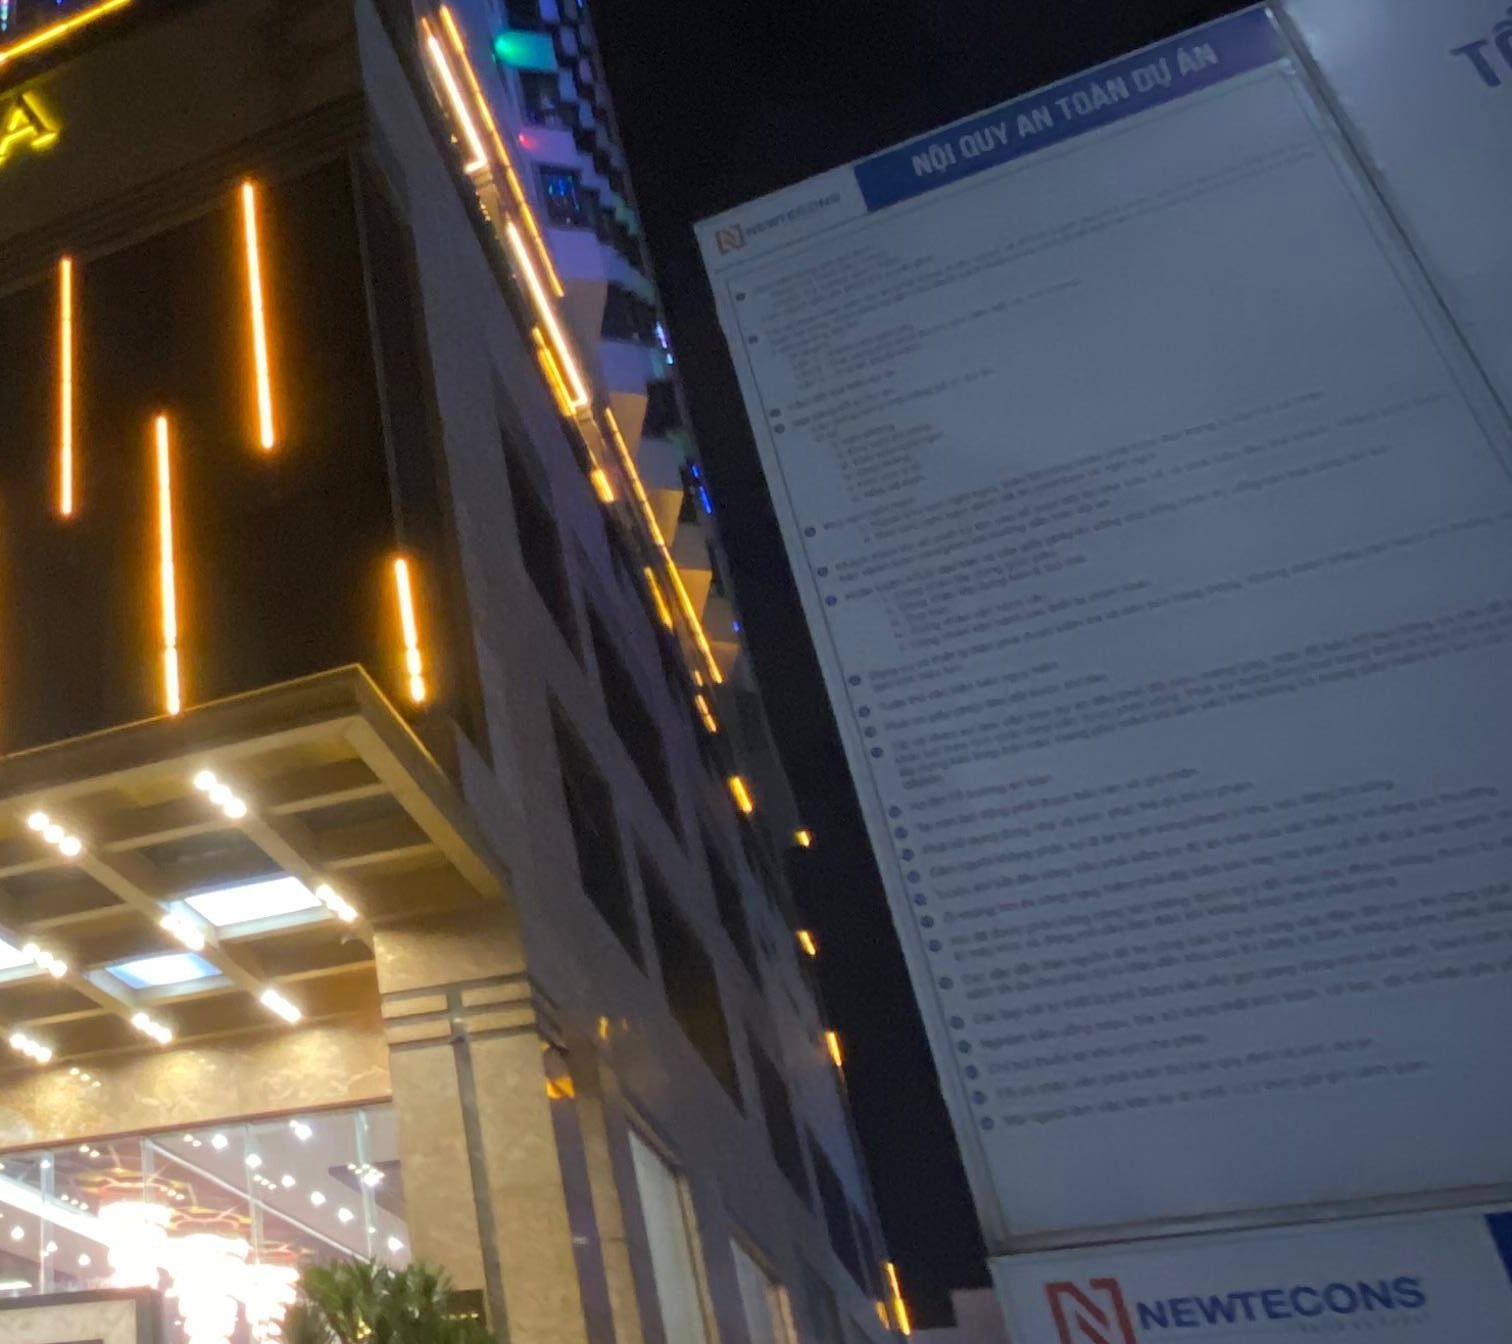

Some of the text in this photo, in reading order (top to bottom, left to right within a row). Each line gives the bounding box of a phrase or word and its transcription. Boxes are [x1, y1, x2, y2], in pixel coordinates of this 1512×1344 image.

[911, 142, 958, 178] NỘI
[960, 120, 1009, 160] QUY
[1016, 105, 1055, 138] AN
[1055, 75, 1130, 121] TOÀN
[1132, 55, 1174, 93] DỰ
[1135, 1275, 1427, 1332] NEWTECONS
